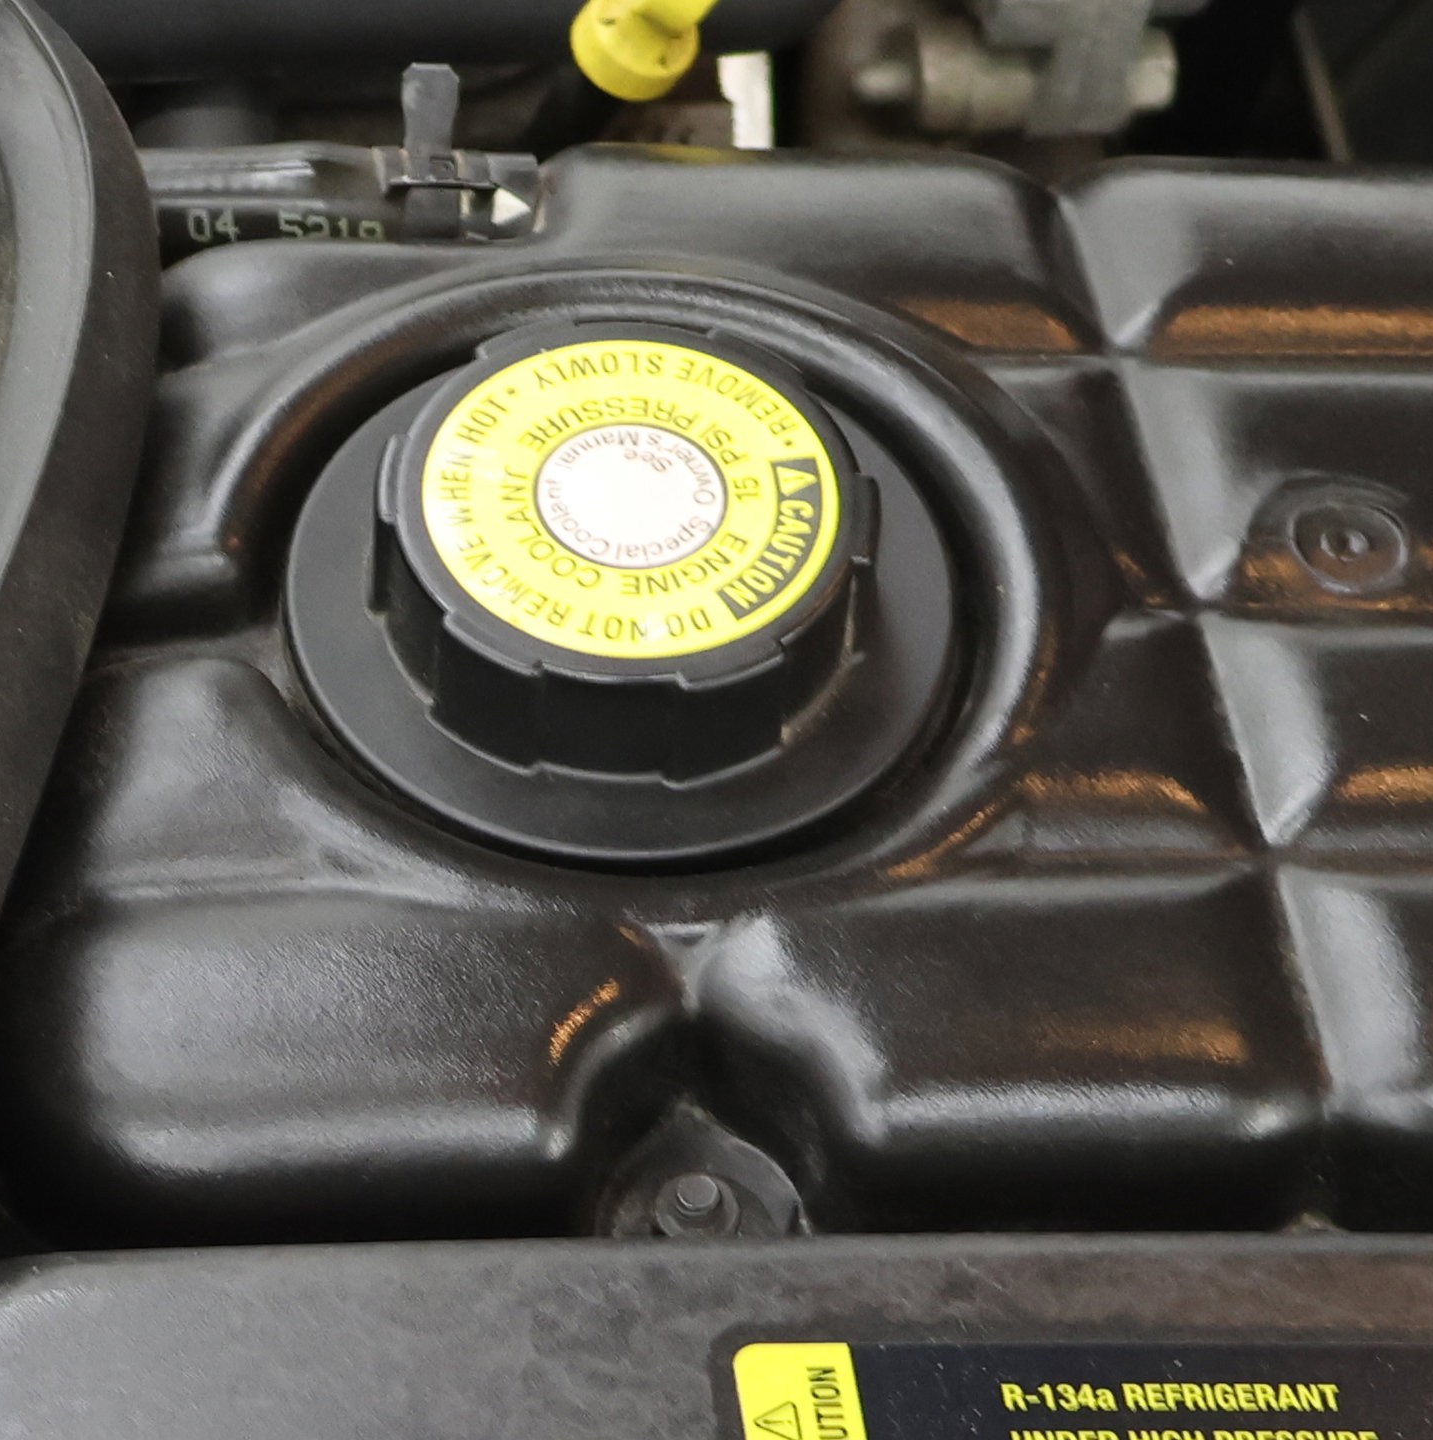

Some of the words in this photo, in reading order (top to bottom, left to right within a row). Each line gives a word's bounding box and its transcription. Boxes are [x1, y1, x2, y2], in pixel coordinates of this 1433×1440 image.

[186, 208, 240, 243] 04
[532, 352, 663, 390] SLOWLY
[453, 393, 505, 446] HOT
[673, 359, 797, 441] REMOVE
[518, 397, 696, 450] PRESSURE
[701, 423, 745, 463] PSI
[553, 429, 639, 471] Manual
[623, 448, 673, 474] See
[437, 452, 474, 530] WHEN
[732, 477, 759, 502] 15
[499, 463, 602, 588] COOLANT
[544, 479, 610, 557] Coolant
[615, 517, 711, 563] Special
[621, 532, 748, 595] ENGINE
[721, 501, 813, 607] CAUTION
[456, 534, 571, 625] REMOVE
[575, 613, 649, 641] NOT
[666, 607, 711, 639] DO
[1000, 1382, 1117, 1411] R-134a
[1121, 1382, 1339, 1411] REFRIGERANT
